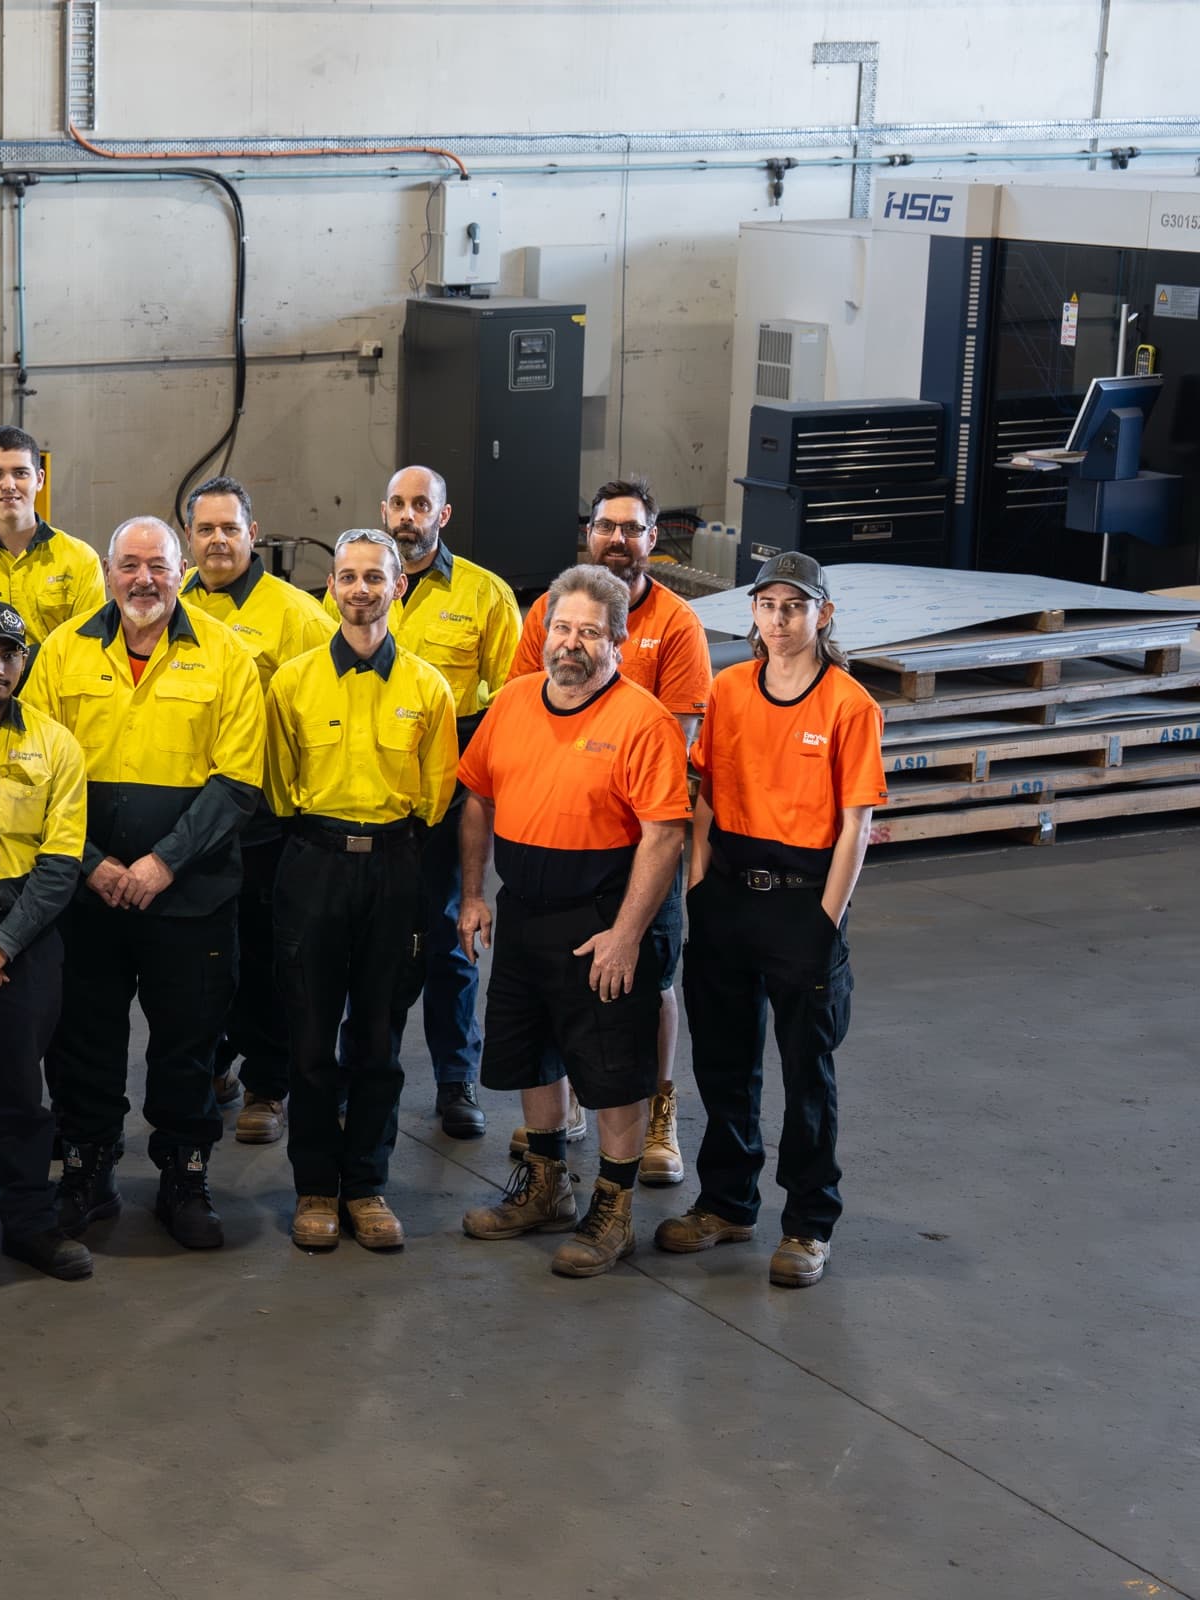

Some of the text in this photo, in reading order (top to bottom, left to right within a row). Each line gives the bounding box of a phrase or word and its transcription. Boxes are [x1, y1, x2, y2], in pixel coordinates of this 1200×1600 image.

[884, 192, 954, 223] HSG
[894, 755, 928, 770] ASD
[1011, 781, 1043, 795] ASD
